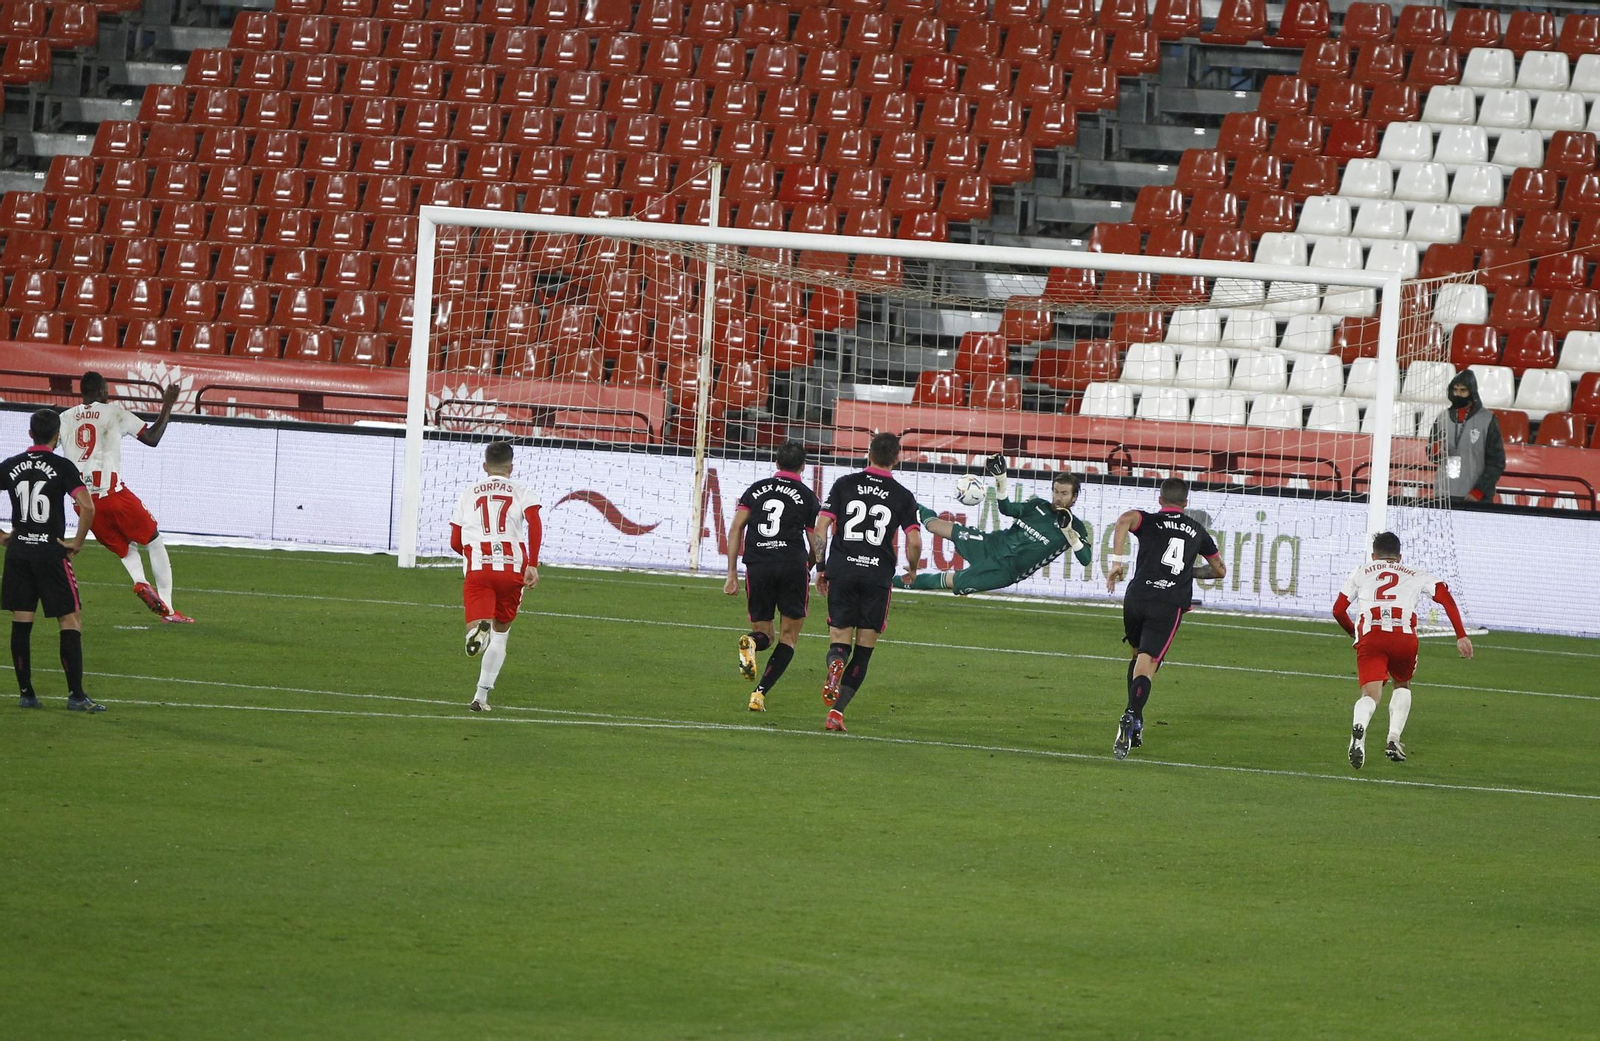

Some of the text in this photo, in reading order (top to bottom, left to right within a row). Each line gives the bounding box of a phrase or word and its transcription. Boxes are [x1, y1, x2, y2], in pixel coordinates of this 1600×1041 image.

[75, 410, 101, 421] SADIQ
[75, 423, 97, 462] 9
[9, 460, 58, 481] AITOR SANZ
[14, 480, 50, 524] 16
[752, 484, 804, 505] ALEX MUÑOZ
[473, 494, 514, 536] 17
[757, 498, 786, 538] 3
[843, 499, 892, 547] 23
[1163, 520, 1198, 539] WILSON
[1015, 518, 1051, 546] TENERIFE
[1160, 537, 1186, 576] 4
[1364, 564, 1387, 575] AITOR
[1373, 571, 1400, 602] 2
